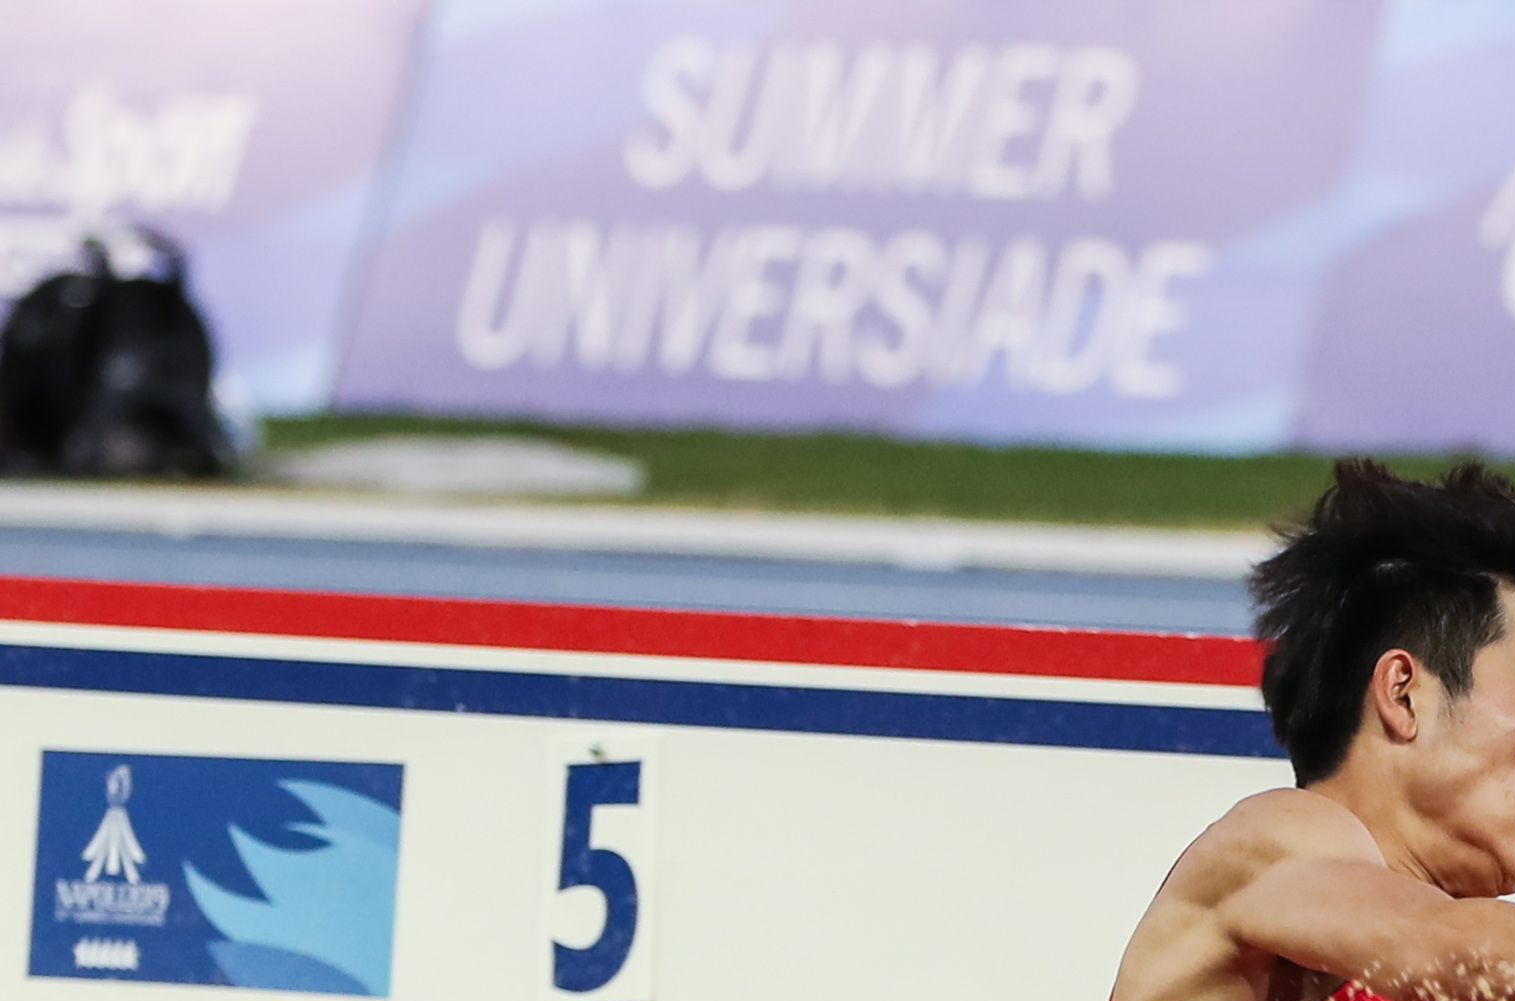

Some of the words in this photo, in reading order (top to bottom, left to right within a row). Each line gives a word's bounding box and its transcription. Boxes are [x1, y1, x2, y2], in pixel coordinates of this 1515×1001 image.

[624, 37, 1137, 200] SUMMER
[456, 217, 1210, 397] UNIVERSIADE
[552, 761, 642, 993] 5
